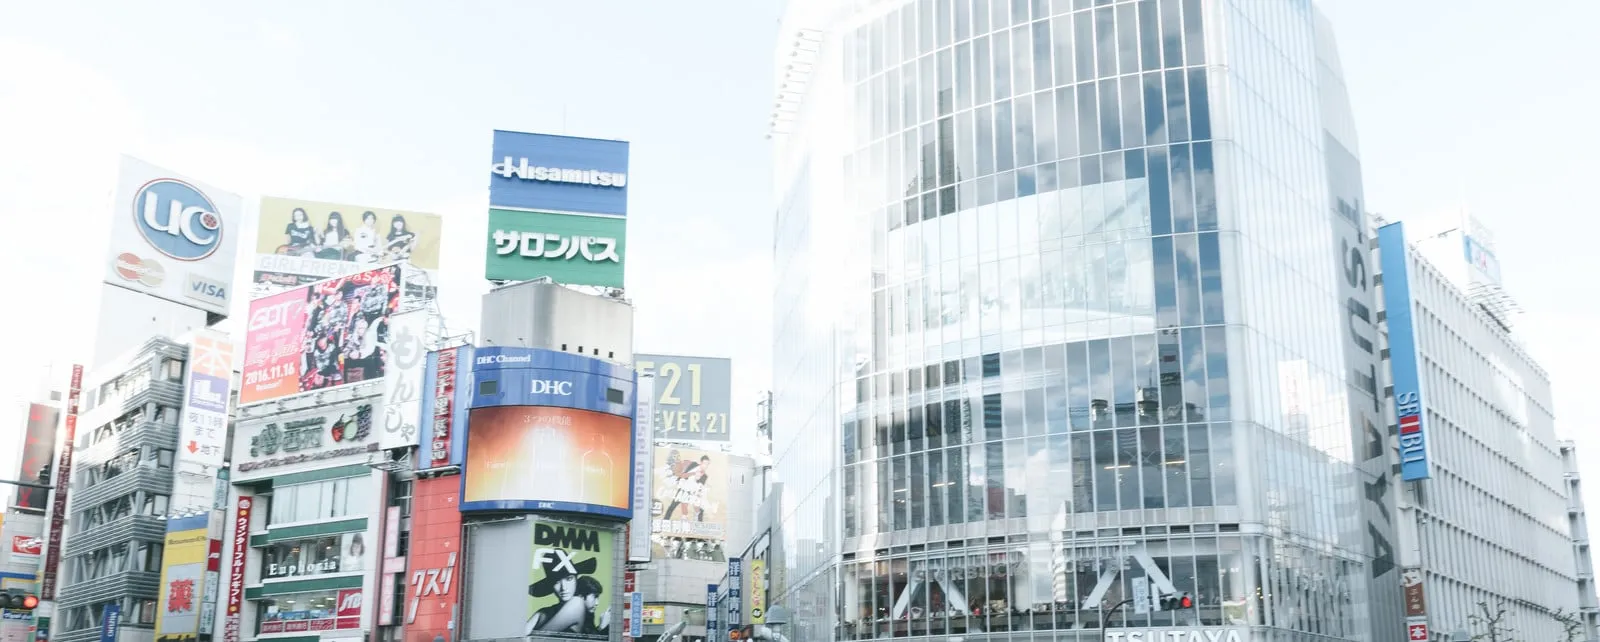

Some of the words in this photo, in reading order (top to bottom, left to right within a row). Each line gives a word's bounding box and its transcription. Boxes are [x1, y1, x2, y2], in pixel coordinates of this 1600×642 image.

[491, 156, 627, 188] Hisamitsu
[492, 228, 620, 263] サロンパス
[192, 279, 226, 299] VISA
[477, 356, 496, 365] DHC
[496, 354, 531, 363] Channel
[384, 324, 422, 438] もんじゃ
[530, 379, 572, 396] DHC
[1336, 197, 1395, 579] TSUTAYA
[706, 412, 727, 434] 21
[1397, 392, 1424, 464] SEIBU
[534, 523, 600, 552] DMM
[269, 558, 337, 577] Euphoria
[533, 548, 578, 574] FX
[407, 551, 457, 624] クスリ
[339, 592, 362, 612] JTB
